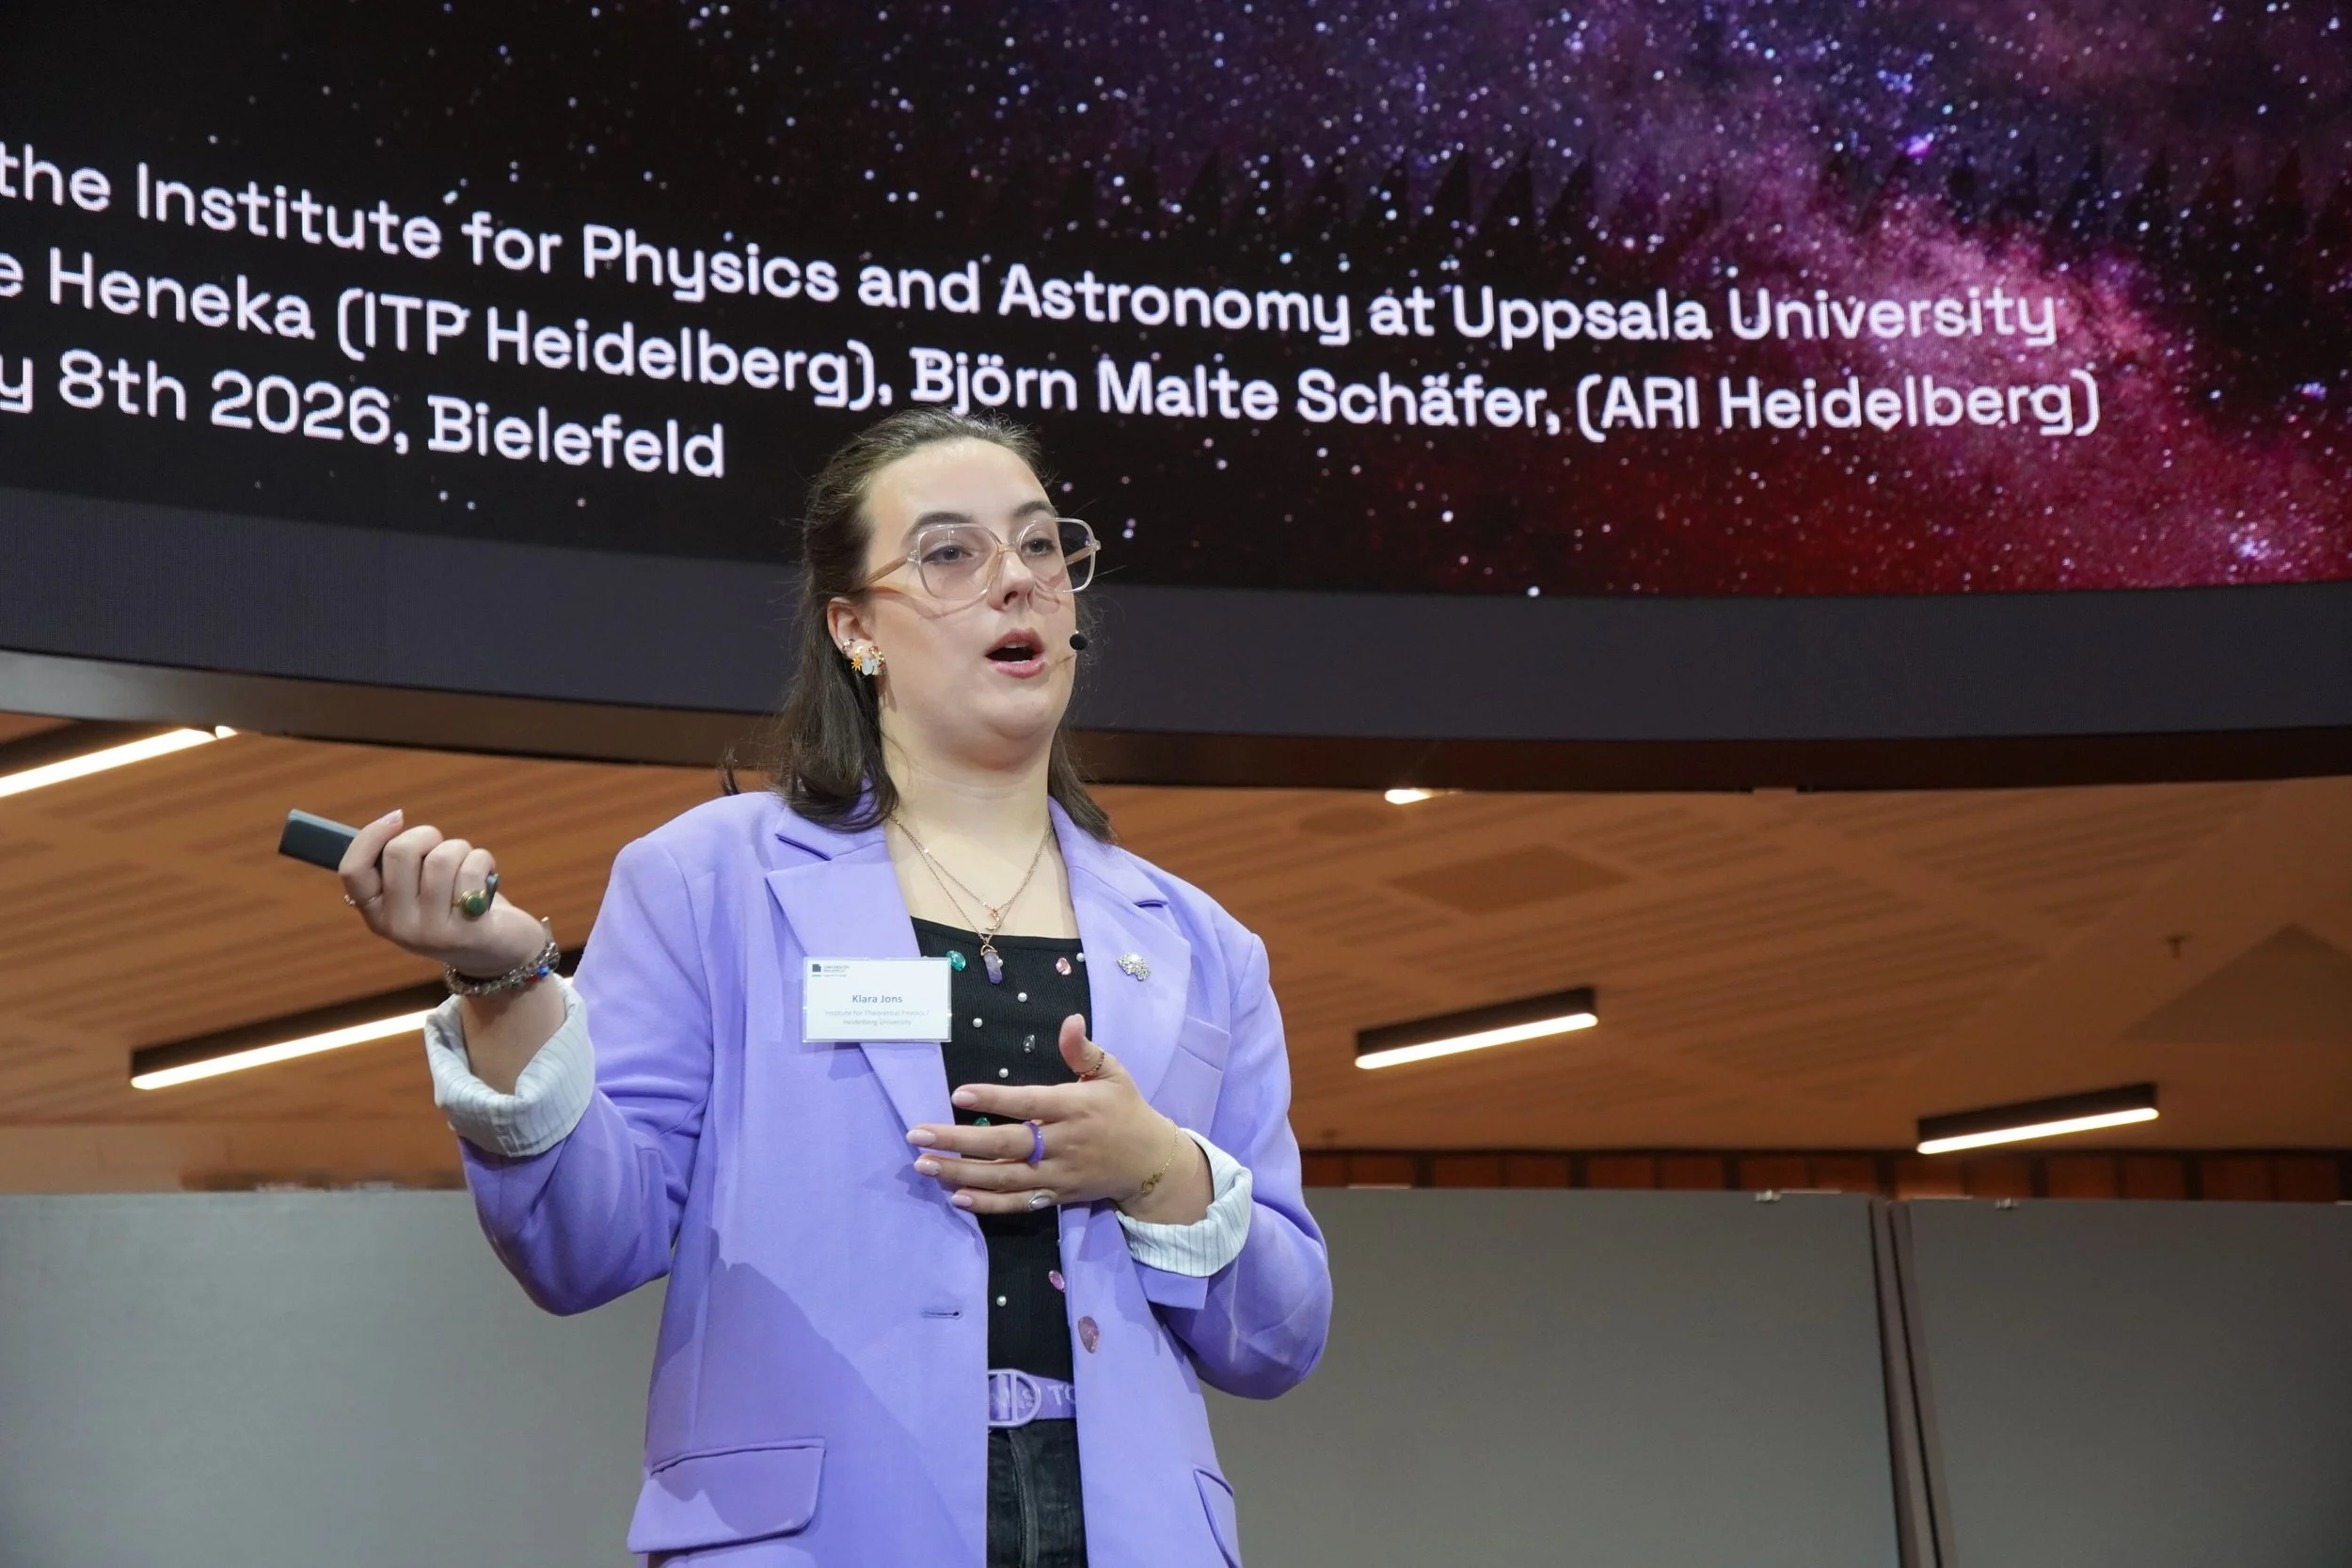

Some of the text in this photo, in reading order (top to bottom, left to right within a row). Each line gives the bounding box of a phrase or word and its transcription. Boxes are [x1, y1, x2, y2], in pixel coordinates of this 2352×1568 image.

[0, 143, 2057, 351] the Institute for Physics and Astronomy at Uppsala University
[49, 247, 315, 341] Heneka
[337, 288, 469, 361] (ITP
[487, 308, 892, 411] Heidelberg),
[911, 346, 1077, 415] Björn
[1097, 359, 1279, 419] Malte
[1297, 369, 1561, 434] Schäfer,
[1576, 374, 1699, 442] (ARI
[1720, 367, 2099, 437] Heidelberg)
[59, 349, 186, 420] 8th
[210, 370, 409, 453] 2026,
[427, 394, 723, 478] Bielefeld
[851, 994, 903, 1004] Klara Jons
